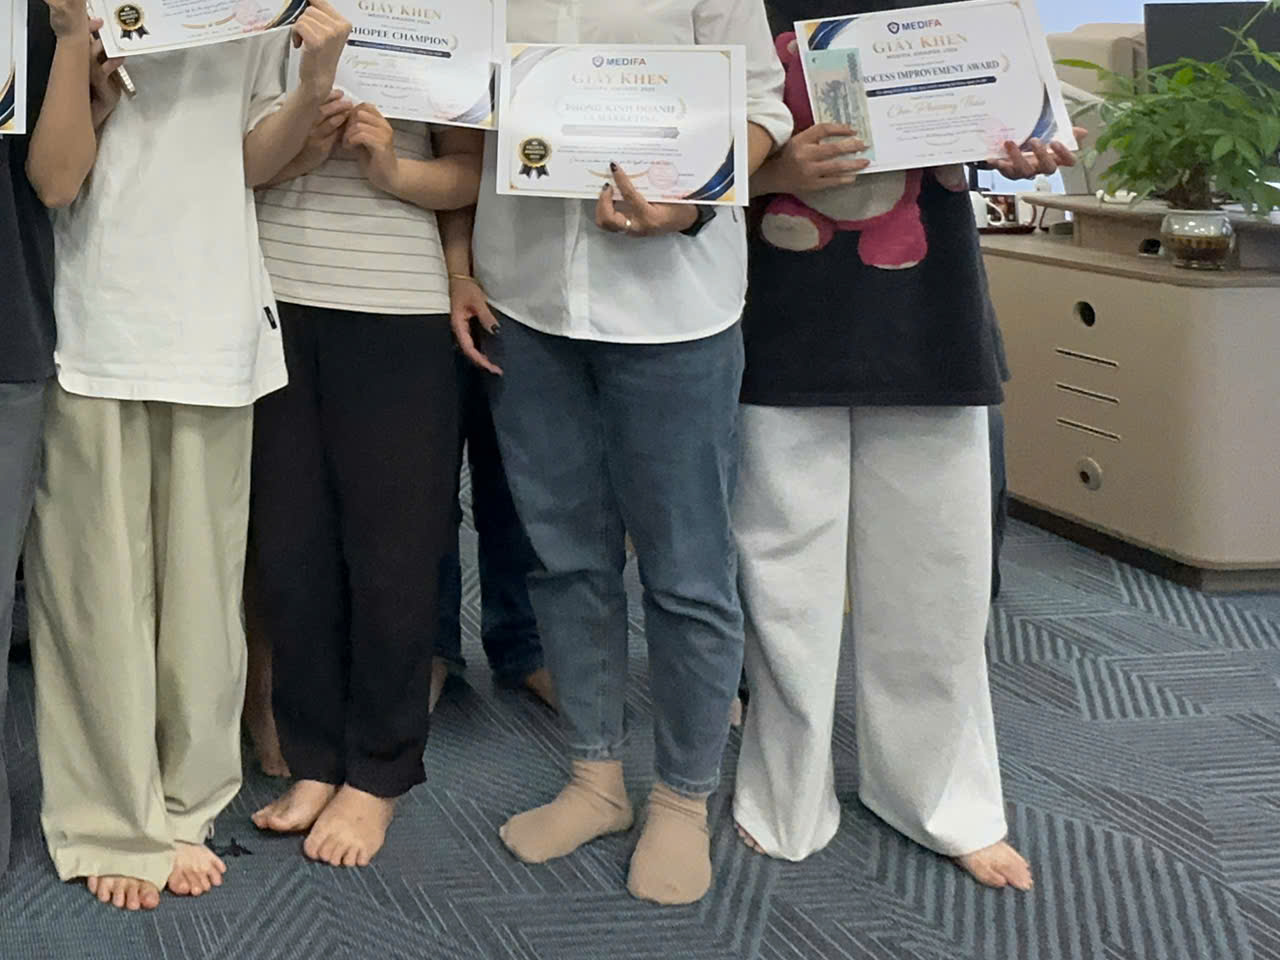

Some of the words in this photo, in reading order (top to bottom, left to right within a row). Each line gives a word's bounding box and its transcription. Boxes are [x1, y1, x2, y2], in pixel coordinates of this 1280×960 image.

[400, 5, 441, 20] KHEN
[901, 19, 943, 31] MEDIFA
[392, 31, 449, 46] CHAMPION
[920, 32, 968, 50] KHEN
[606, 58, 647, 66] MEDIFA
[621, 72, 669, 85] KHEN
[896, 64, 965, 82] IMPROVEMENT
[967, 60, 1000, 73] AWARD
